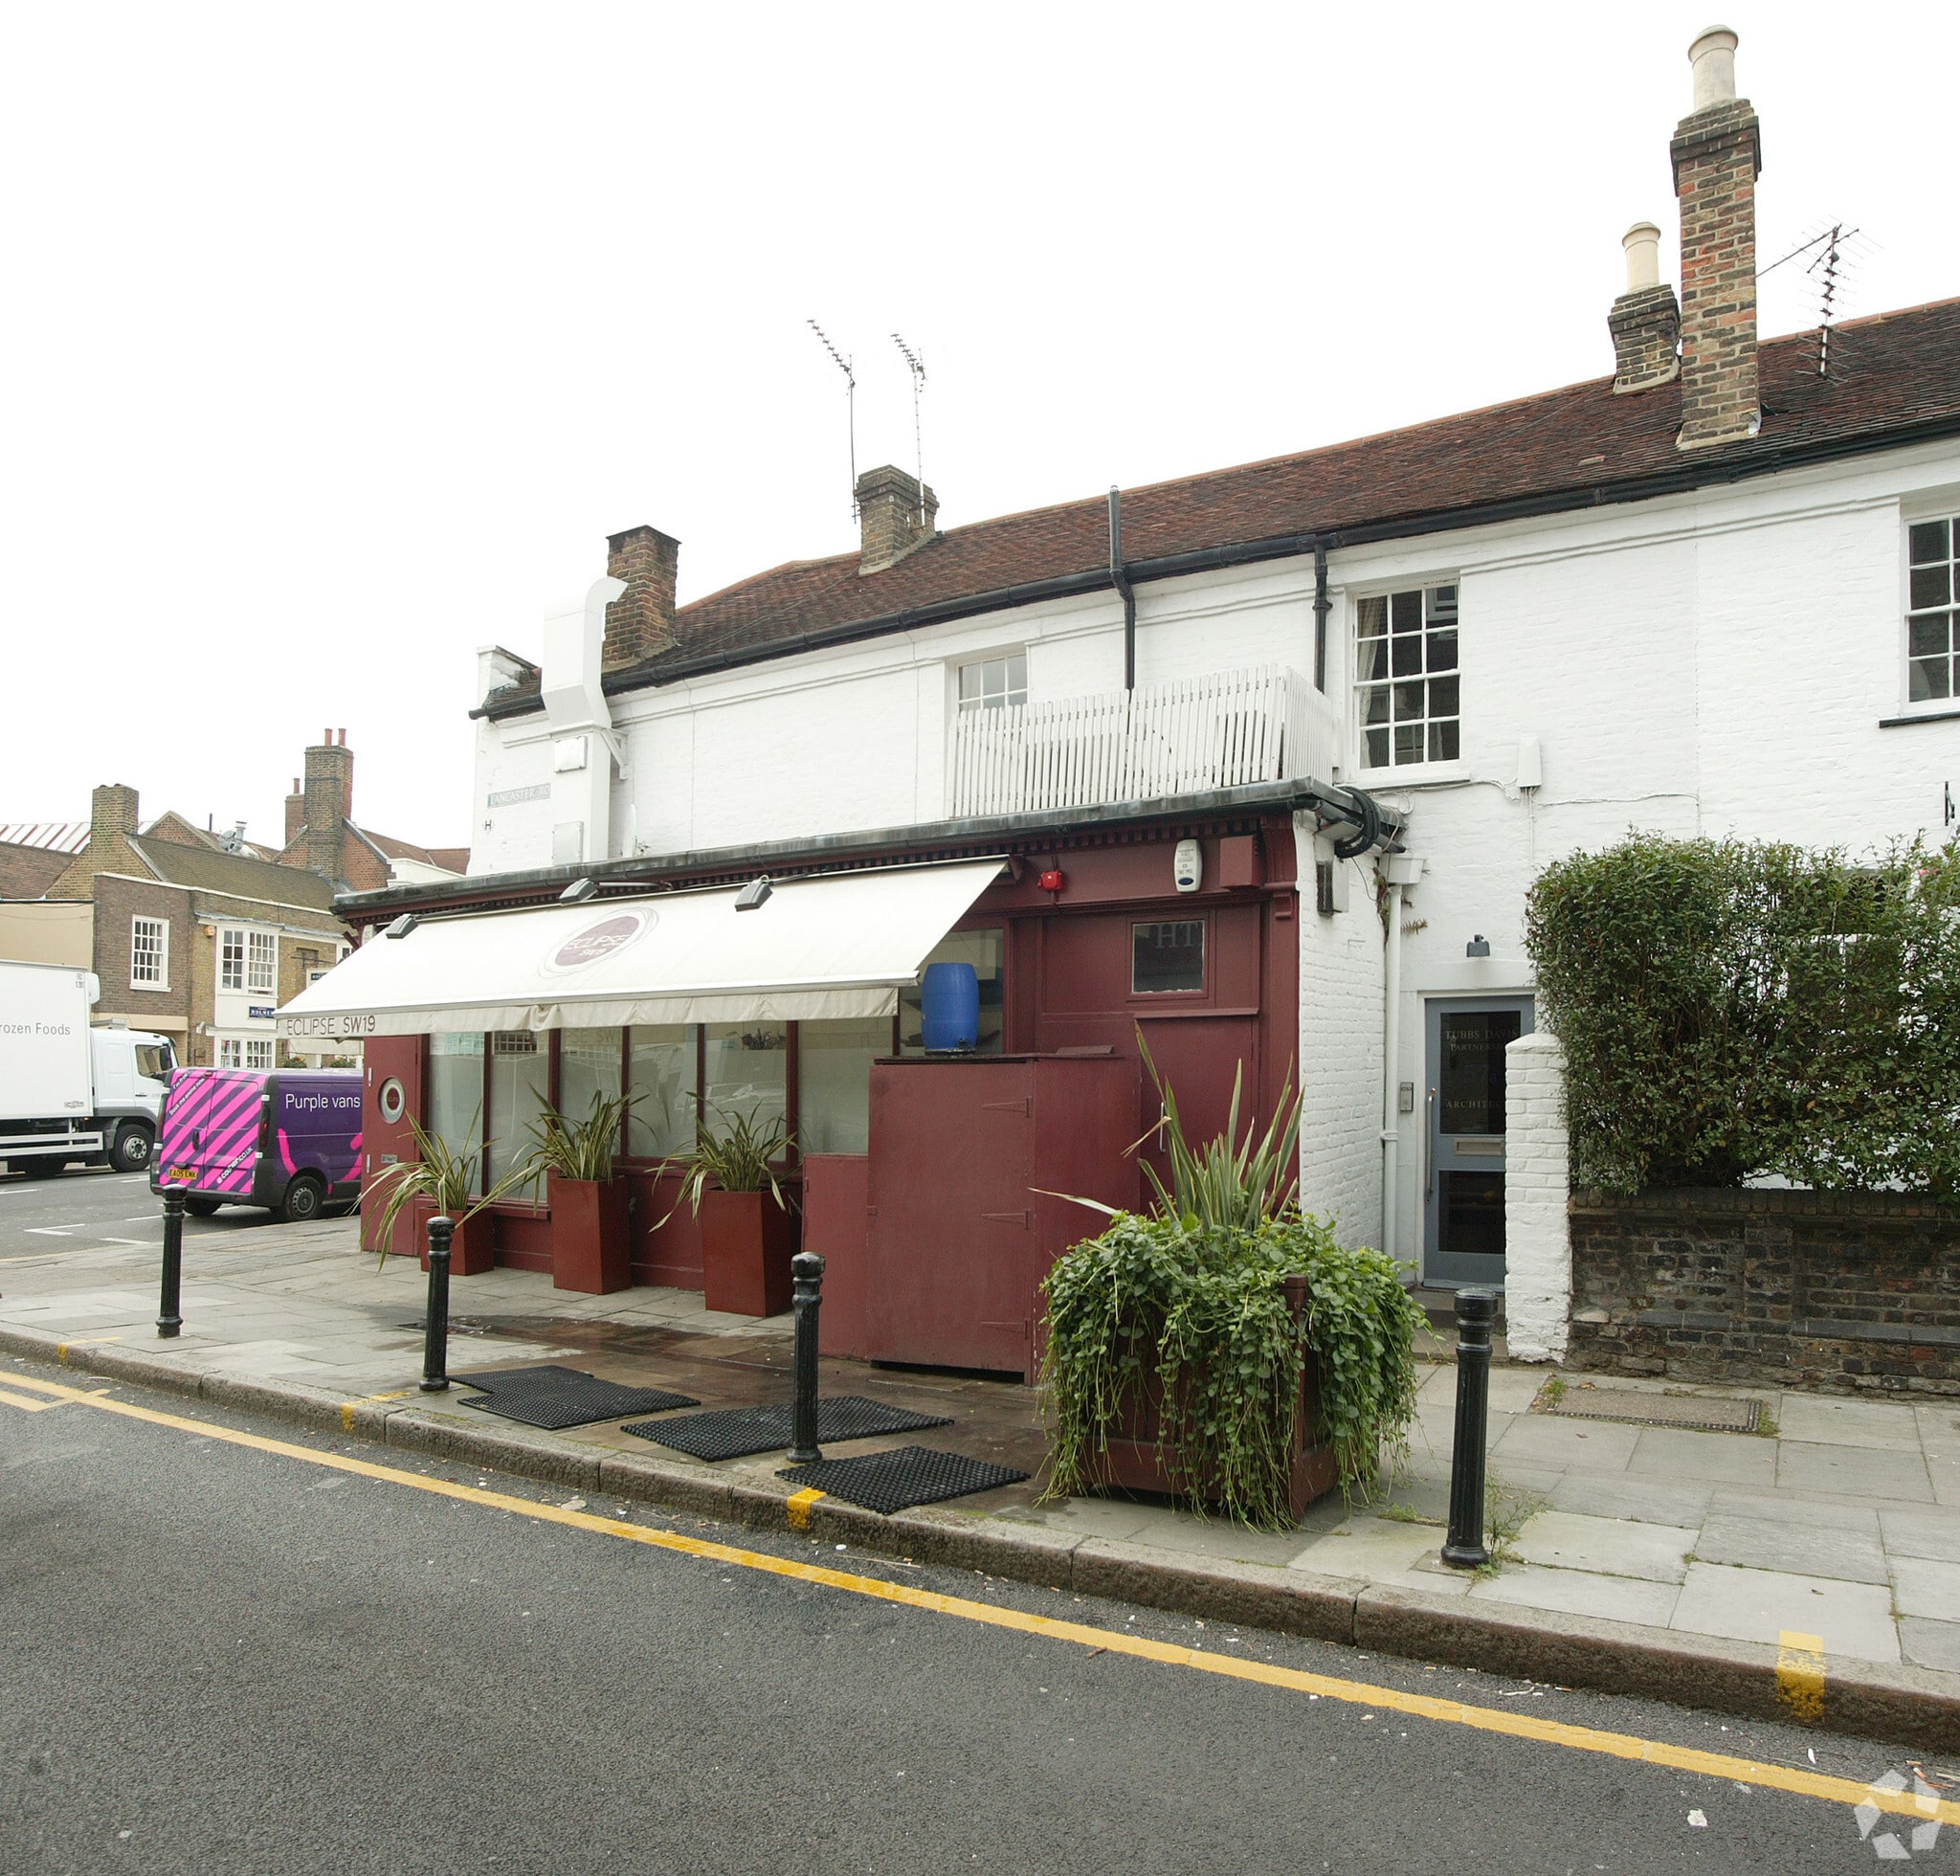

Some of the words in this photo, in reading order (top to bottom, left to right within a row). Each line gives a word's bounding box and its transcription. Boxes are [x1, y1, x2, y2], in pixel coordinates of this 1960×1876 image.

[490, 788, 535, 805] LANCASTER
[35, 1022, 71, 1036] Foods
[286, 1017, 336, 1036] ECLIPSE
[343, 1015, 376, 1034] SW19
[1444, 1029, 1481, 1040] TUBBS
[285, 1093, 328, 1112] Purple
[332, 1096, 361, 1108] vans
